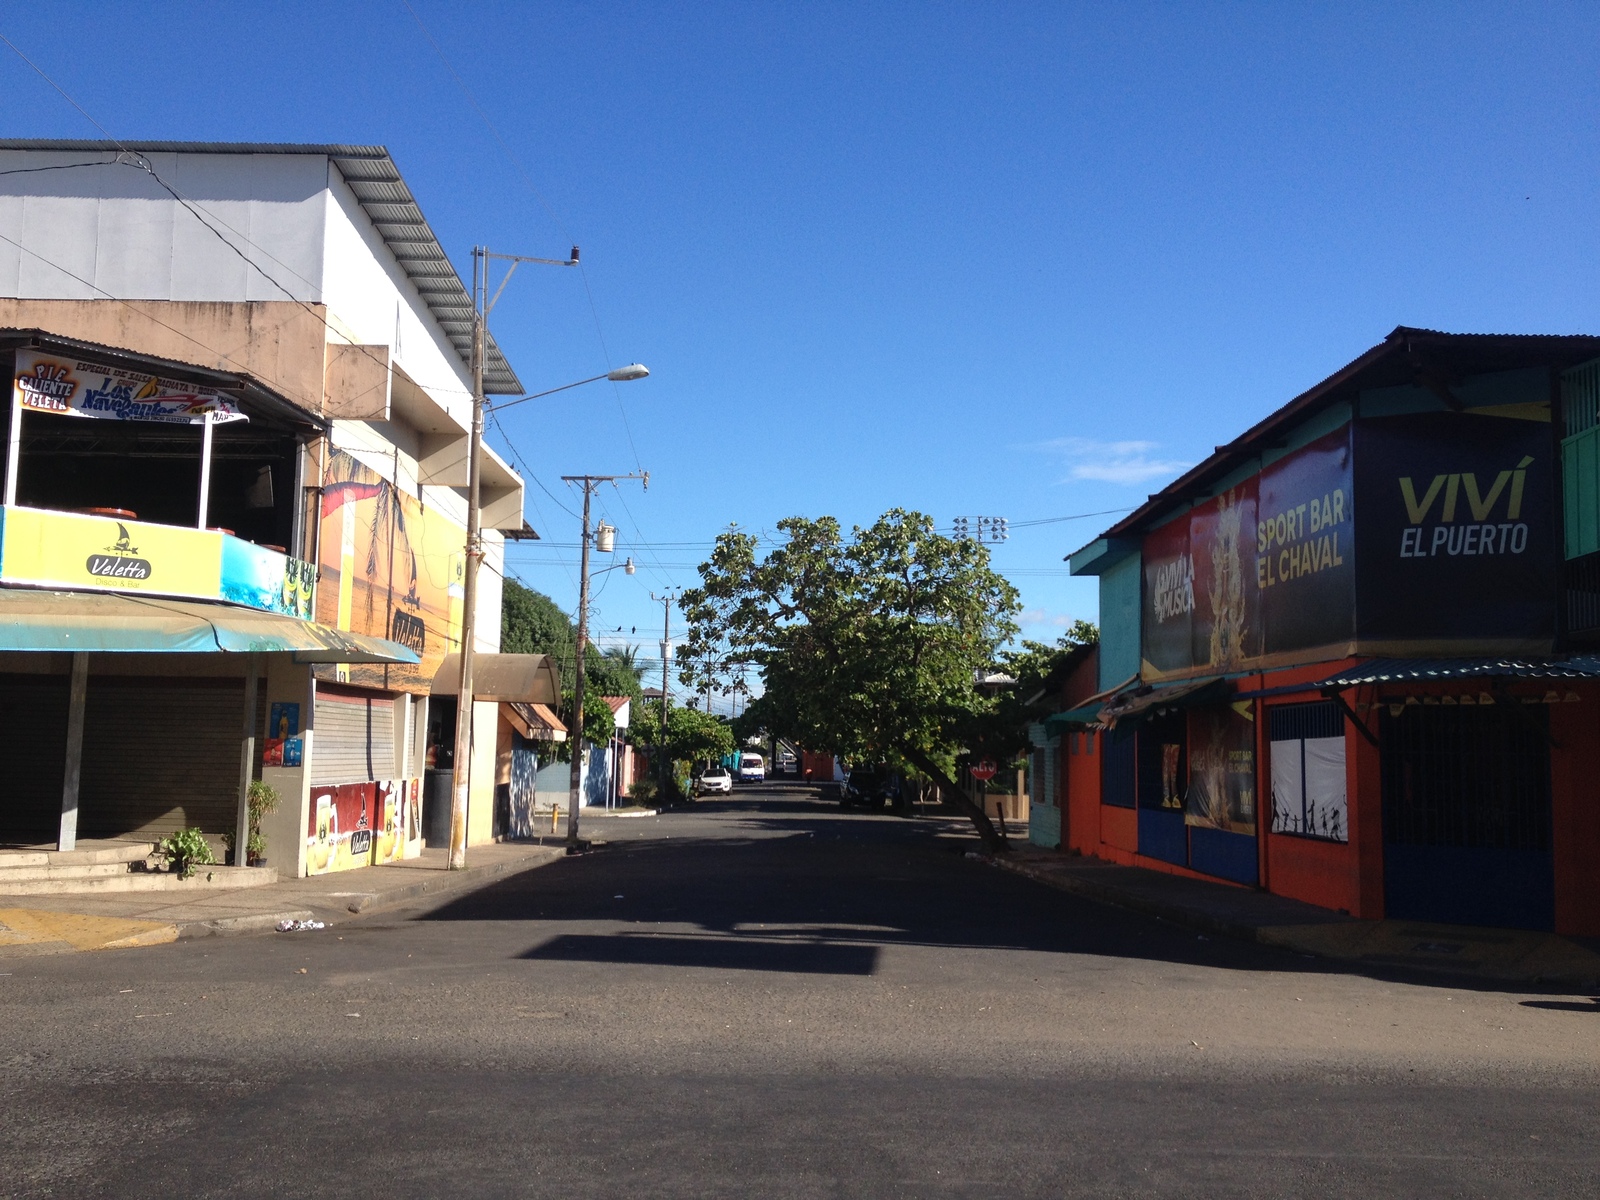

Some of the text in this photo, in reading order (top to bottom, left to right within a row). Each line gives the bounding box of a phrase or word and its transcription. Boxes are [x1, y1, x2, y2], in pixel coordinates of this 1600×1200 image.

[19, 376, 74, 396] CALIENTE
[36, 364, 66, 382] PIE
[76, 362, 111, 376] ESPECIAL
[113, 369, 127, 378] DE
[191, 385, 198, 393] Y
[24, 390, 67, 410] VELETA
[97, 377, 133, 400] Los
[81, 389, 178, 418] Navegantes
[1399, 455, 1535, 524] VIVÍ
[1257, 488, 1344, 552] SPORT BAR
[1400, 523, 1528, 557] EL PUERTO
[91, 557, 146, 578] Veletta
[1257, 532, 1343, 589] EL CHAVAL
[95, 578, 118, 586] Disco
